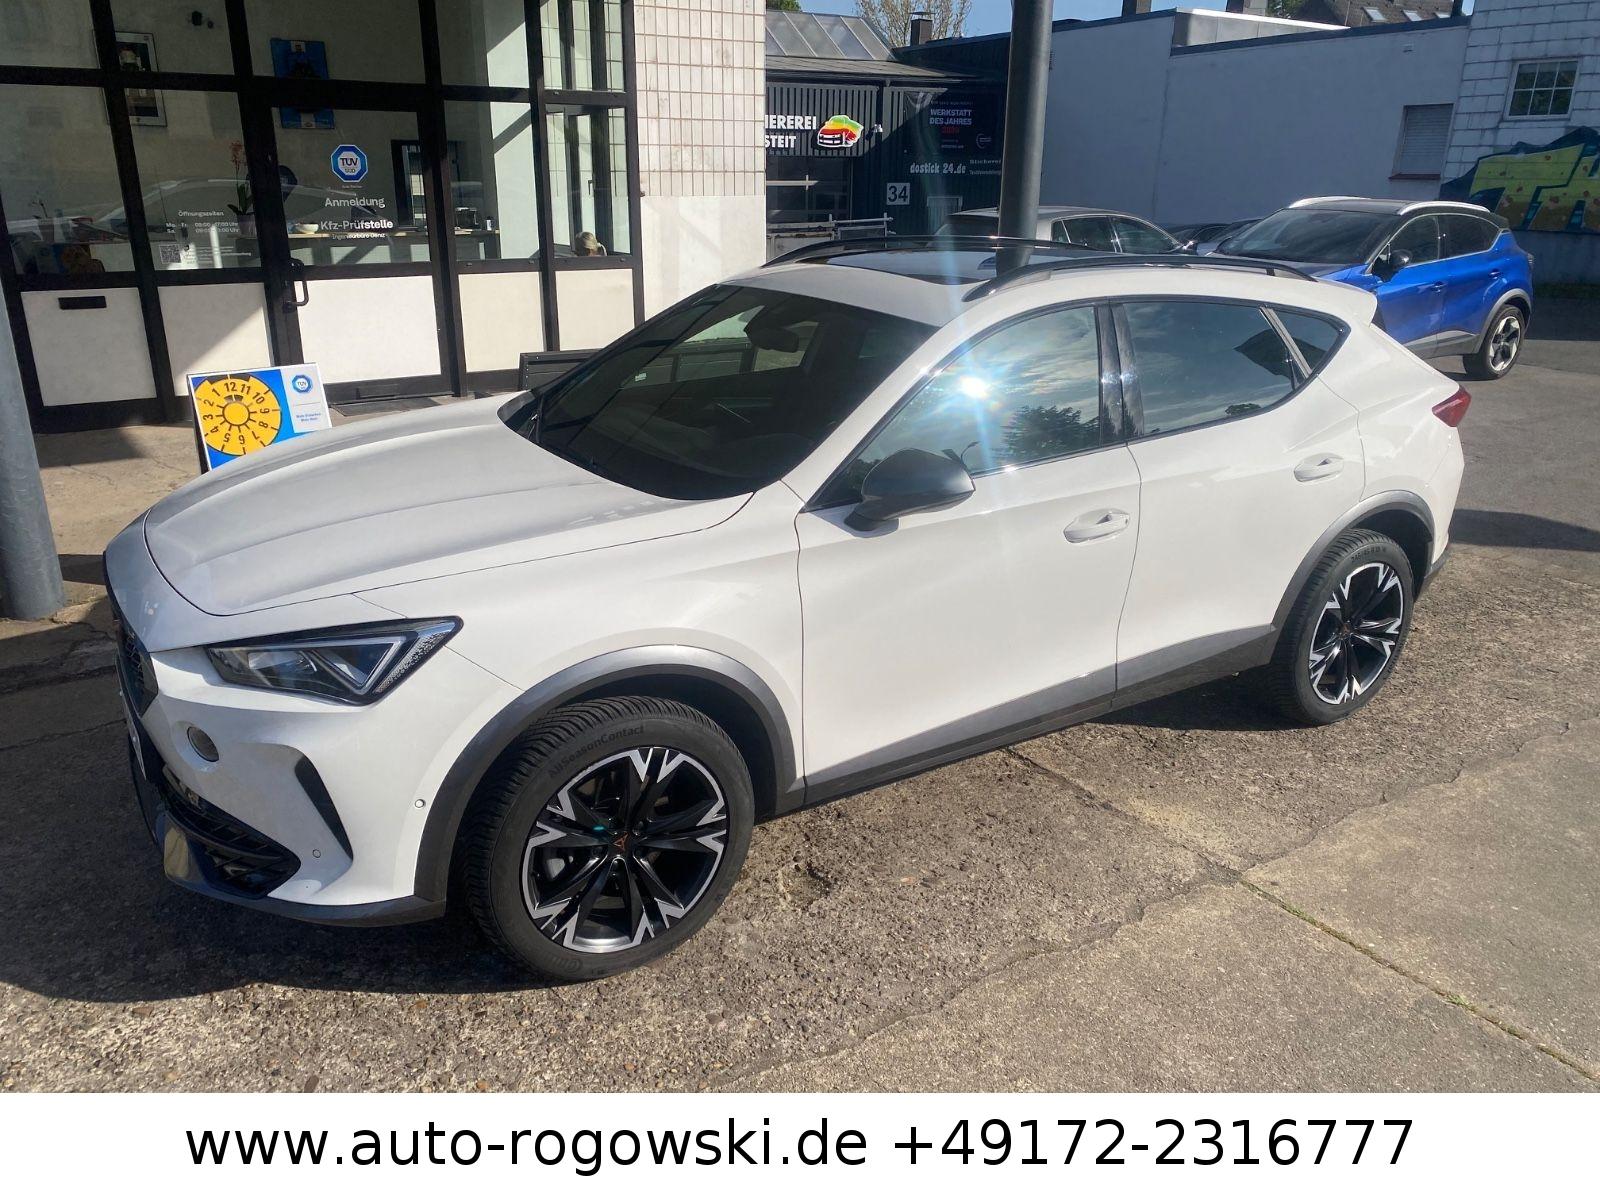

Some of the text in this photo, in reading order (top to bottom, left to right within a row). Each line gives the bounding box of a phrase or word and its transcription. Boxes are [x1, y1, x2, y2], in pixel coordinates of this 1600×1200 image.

[930, 108, 972, 117] WERKSTATT
[929, 117, 972, 126] DES JAHRES
[888, 186, 908, 202] 34
[324, 197, 386, 209] Anmeldung
[178, 209, 224, 218] Öffnungszeiten
[320, 219, 394, 231] Kfz-Prüfstelle
[212, 388, 221, 396] 1
[224, 382, 237, 392] 12
[240, 384, 251, 395] 11
[252, 391, 265, 404] 10
[203, 399, 214, 407] 2
[210, 425, 219, 434] 4
[223, 433, 231, 443] 5
[238, 434, 246, 445] 6
[251, 430, 260, 440] 7
[548, 724, 646, 779] AllSeasonContact
